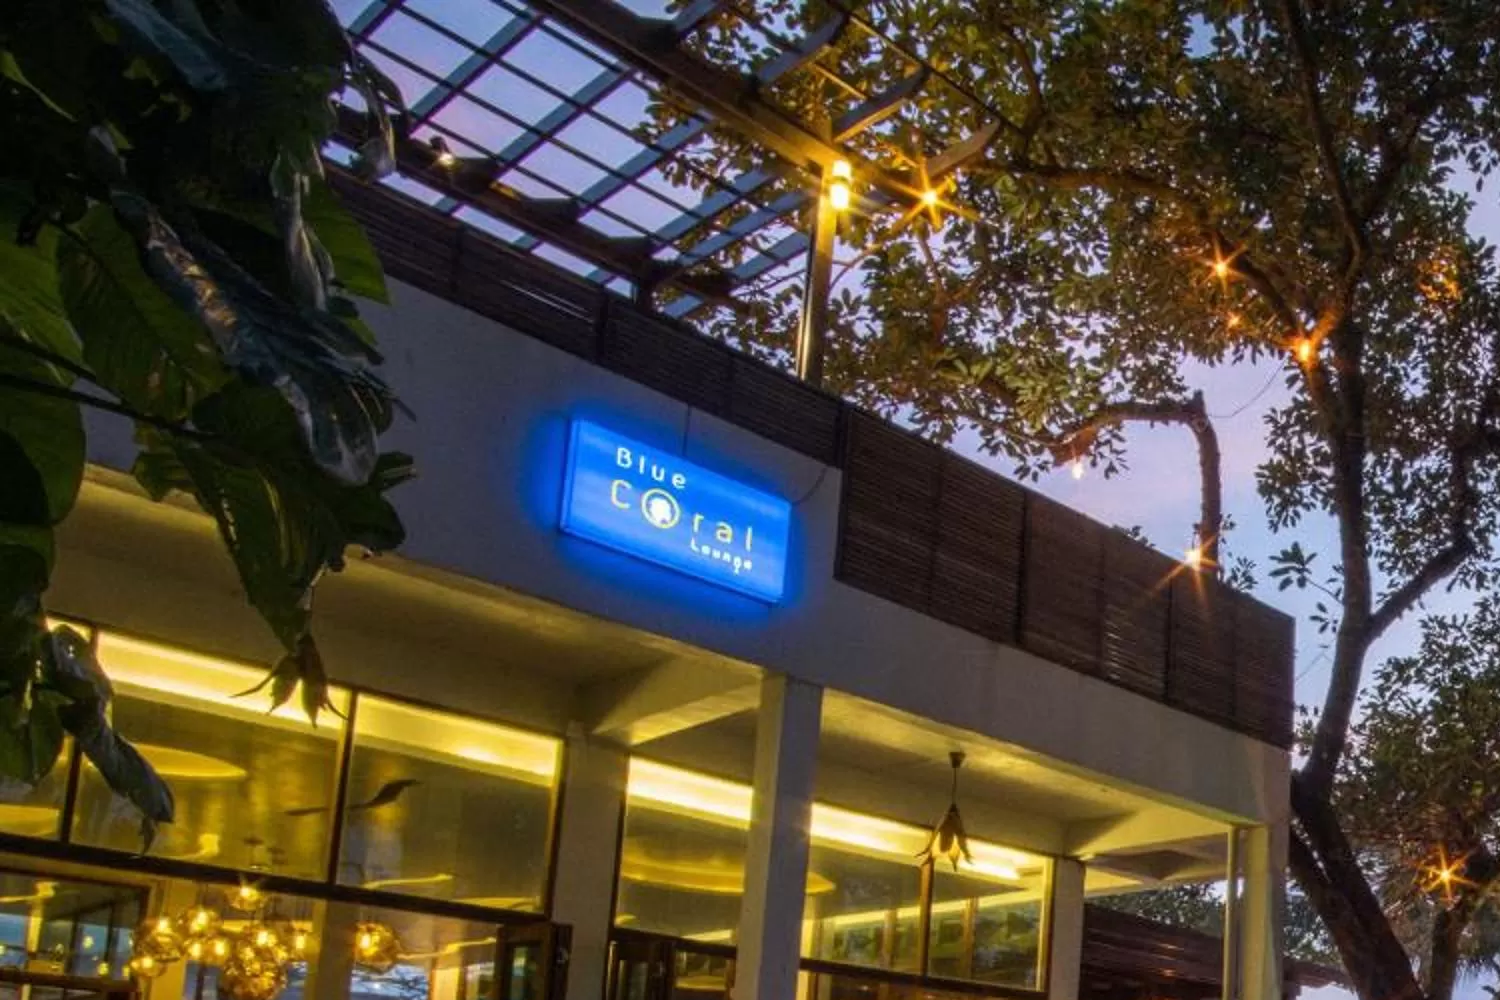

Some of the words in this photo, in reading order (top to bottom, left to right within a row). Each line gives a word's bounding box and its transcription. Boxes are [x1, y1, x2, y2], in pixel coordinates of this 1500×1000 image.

[616, 447, 686, 489] Blue
[611, 479, 753, 552] Coral
[691, 538, 753, 575] Lounge
